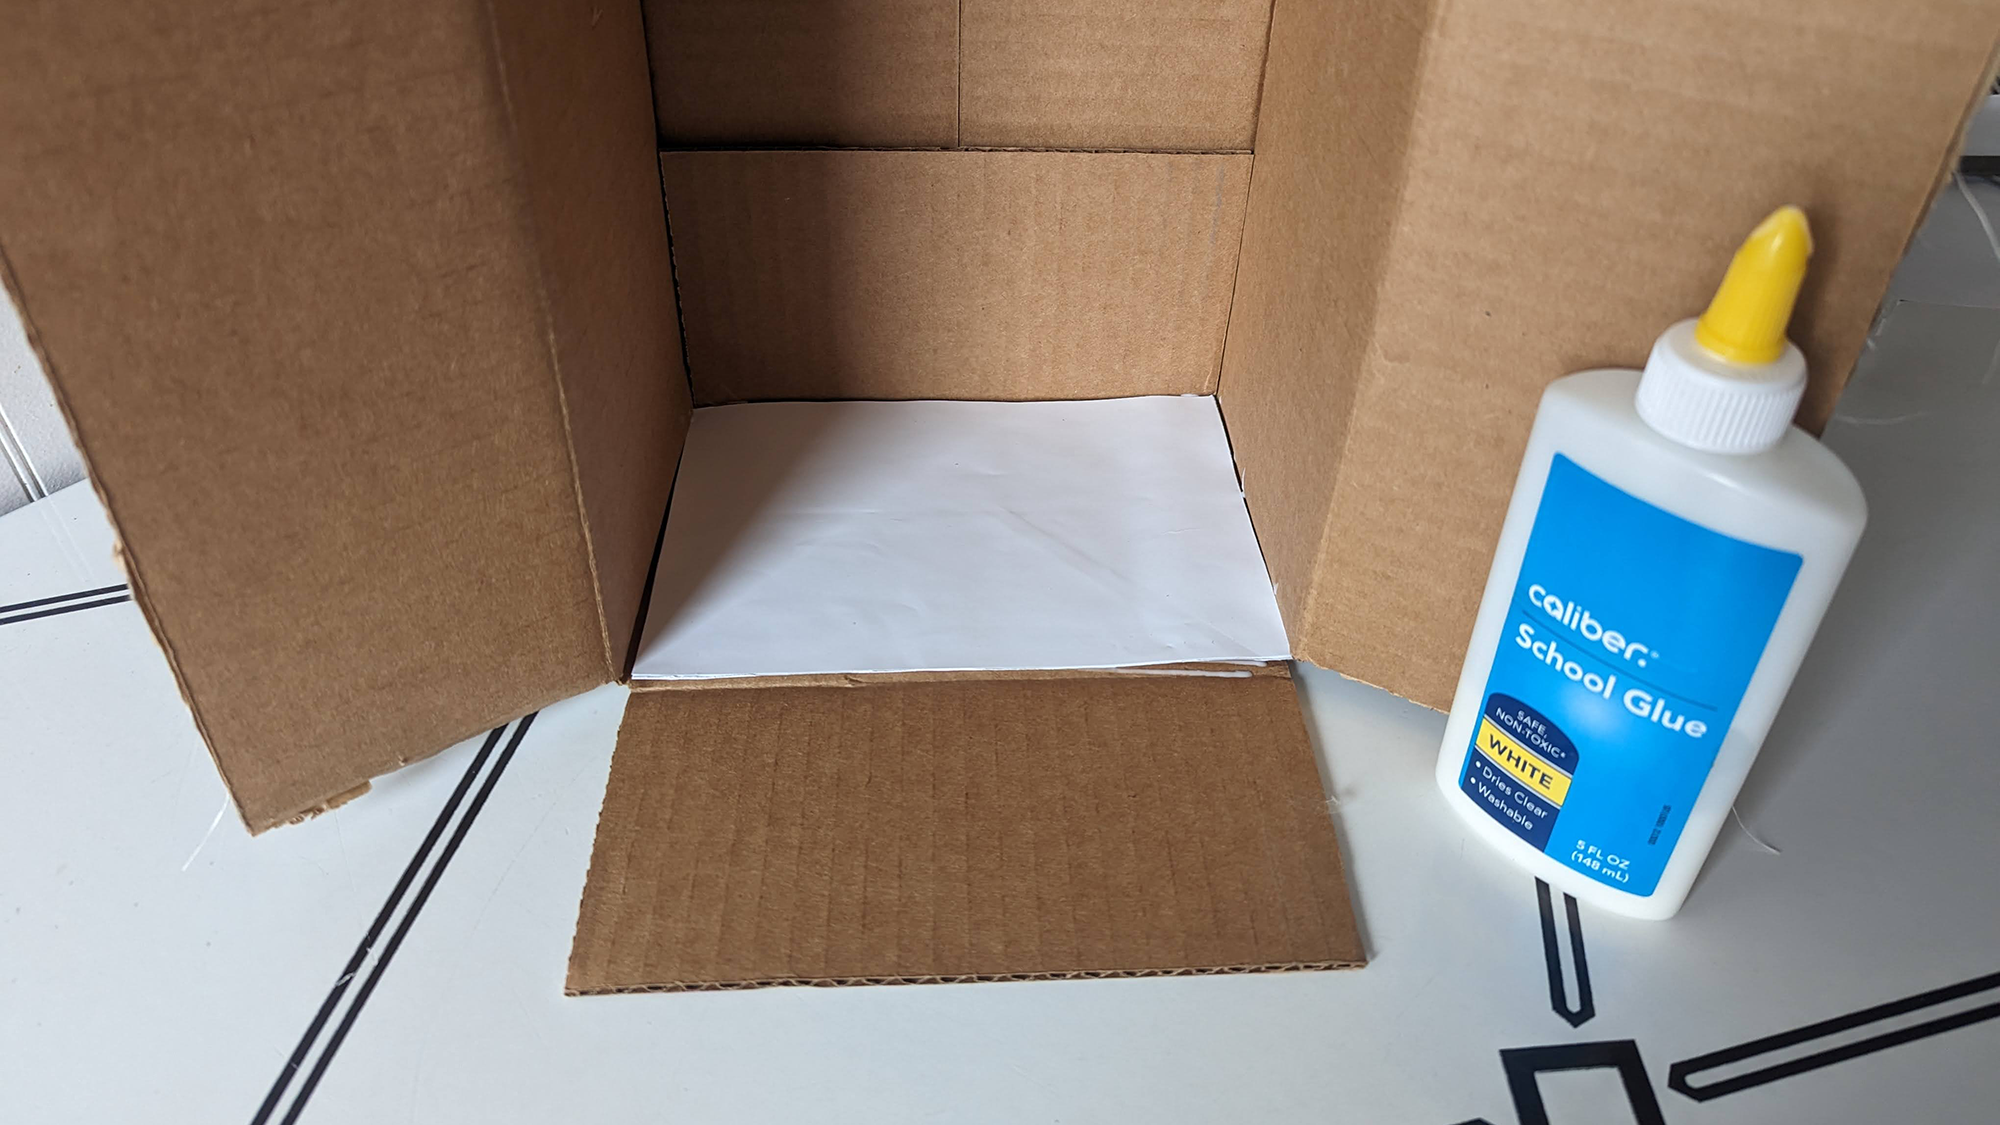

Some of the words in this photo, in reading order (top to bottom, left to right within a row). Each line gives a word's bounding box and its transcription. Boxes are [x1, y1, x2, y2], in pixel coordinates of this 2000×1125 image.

[1515, 623, 1617, 700] School
[1623, 688, 1708, 739] Glue
[1517, 709, 1548, 739] SAFE,
[1489, 734, 1553, 790] WHITE
[1477, 781, 1534, 831] Washable
[1482, 765, 1512, 797] Dries
[1514, 791, 1548, 819] Clear
[1571, 851, 1601, 871] (148
[1602, 866, 1629, 884] mL)
[1576, 840, 1586, 851] 5
[1587, 845, 1604, 861] FL
[1606, 853, 1631, 870] OZ
